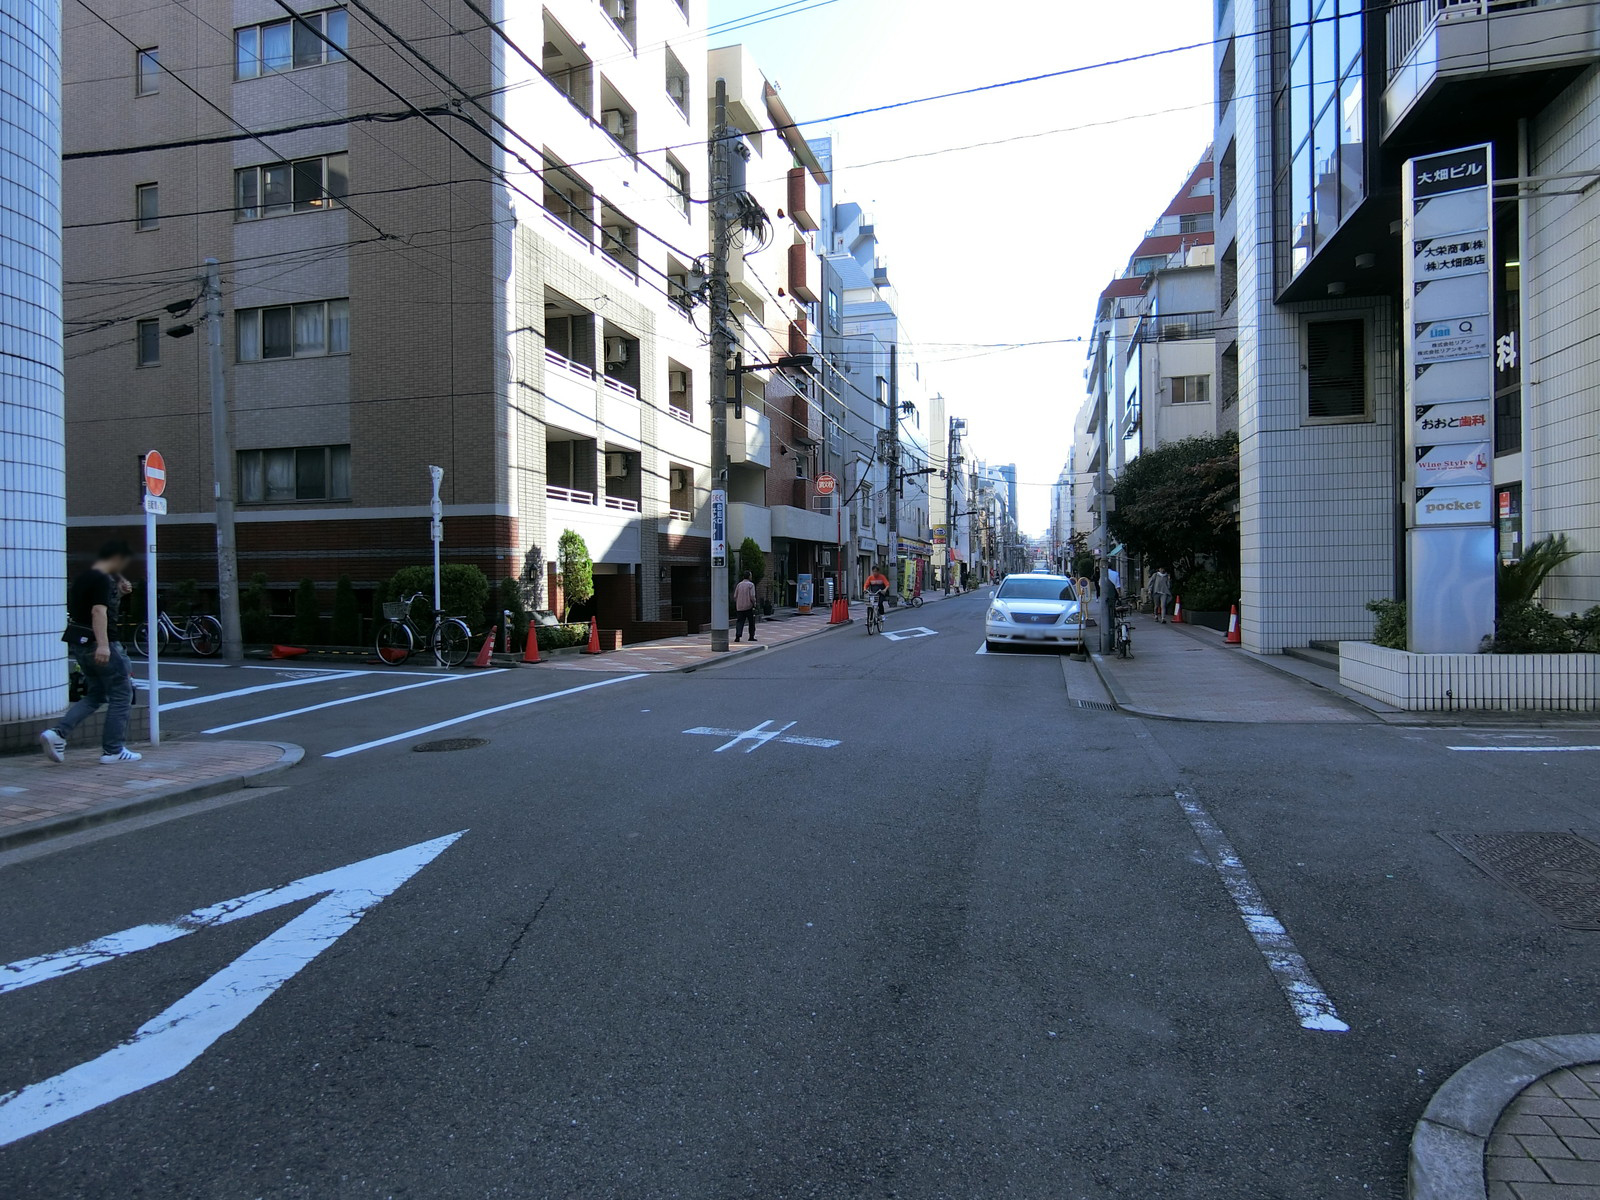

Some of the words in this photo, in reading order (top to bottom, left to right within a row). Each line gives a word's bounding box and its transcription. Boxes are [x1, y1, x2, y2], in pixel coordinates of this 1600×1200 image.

[1417, 163, 1483, 185] 大畑ビル
[1417, 202, 1424, 211] 7
[1415, 243, 1423, 252] 6
[1424, 254, 1486, 272] (株)大畑商店
[1416, 284, 1422, 292] 5
[1459, 321, 1472, 333] Q
[1496, 331, 1516, 372] 科
[1417, 366, 1424, 374] 3
[1416, 407, 1424, 416] 2
[1421, 414, 1486, 430] おおと歯科
[1418, 461, 1442, 469] Wine
[1444, 459, 1474, 467] Styles
[1425, 500, 1482, 514] pocket
